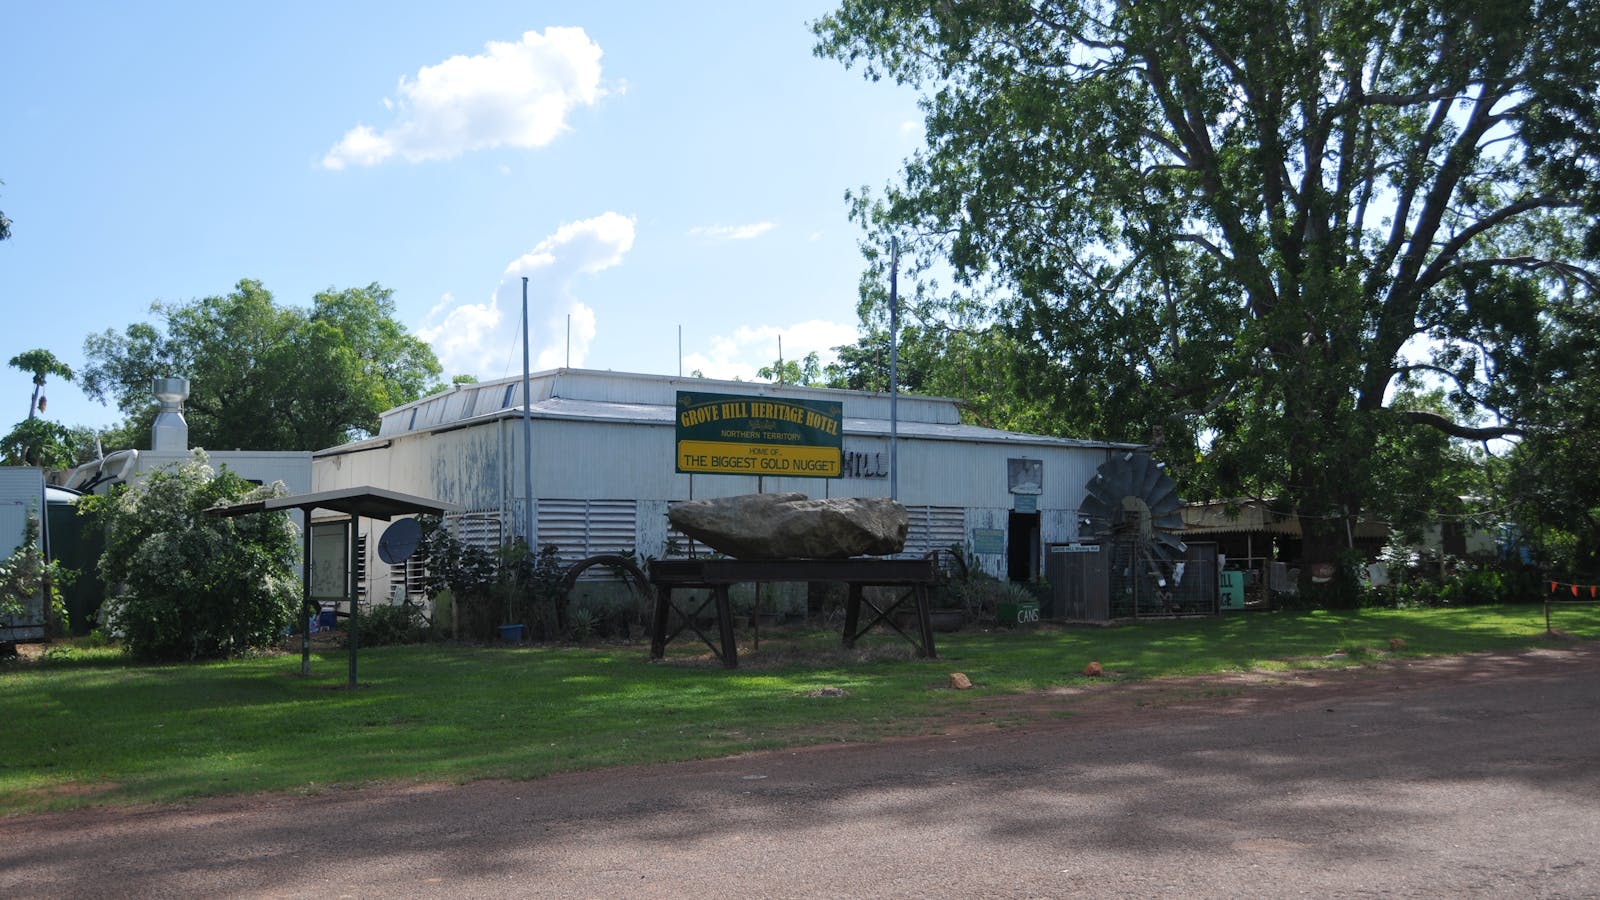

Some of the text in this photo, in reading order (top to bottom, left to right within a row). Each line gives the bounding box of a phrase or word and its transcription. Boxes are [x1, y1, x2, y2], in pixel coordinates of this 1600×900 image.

[681, 402, 839, 436] GROVE HILL HERITAGE HOTEL
[721, 429, 801, 441] NORTHERN TERRITORY
[749, 447, 768, 456] HOME
[684, 454, 836, 472] THE BIGGEST GOLD NUGGET
[1017, 608, 1039, 624] CANS
